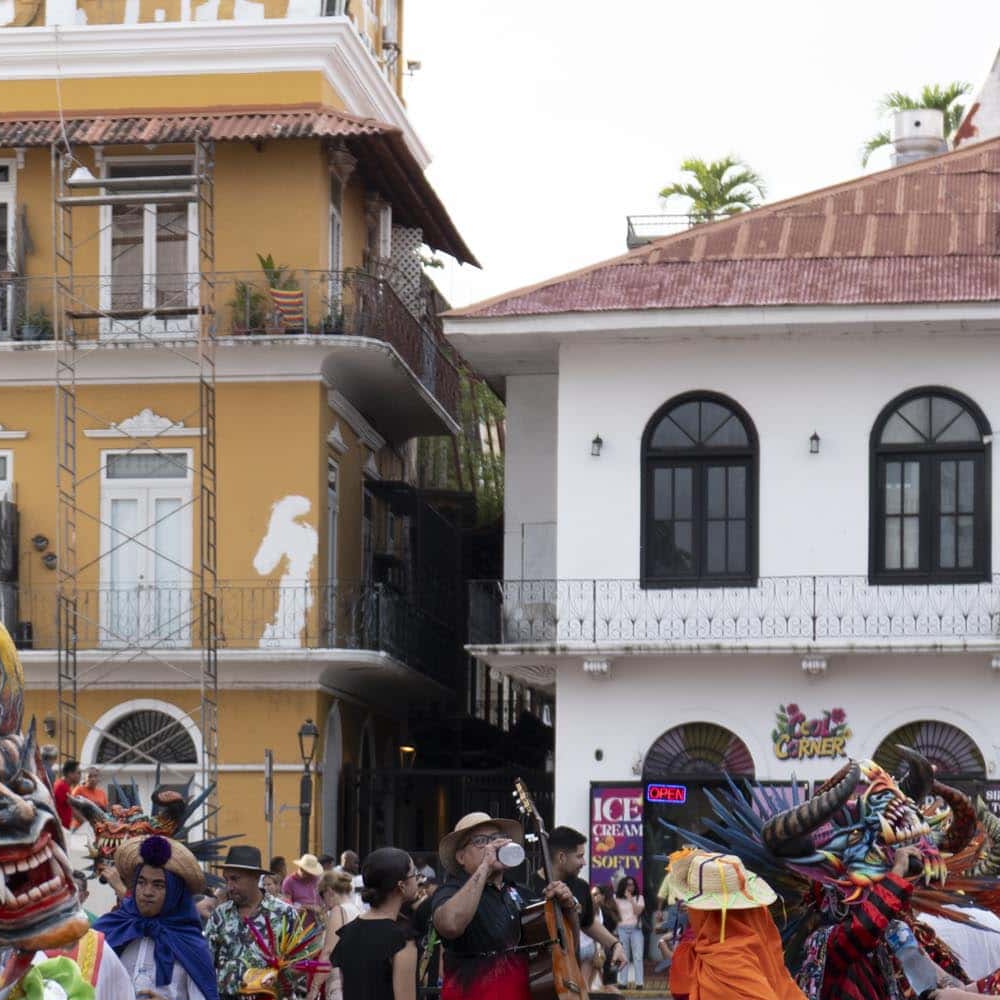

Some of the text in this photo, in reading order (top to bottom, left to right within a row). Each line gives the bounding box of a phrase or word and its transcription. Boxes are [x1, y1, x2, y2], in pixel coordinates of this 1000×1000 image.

[775, 734, 847, 760] CORNER
[650, 787, 684, 801] OPEN
[593, 797, 643, 823] ICE
[592, 824, 643, 837] CREAM
[592, 855, 643, 869] SOFTY
